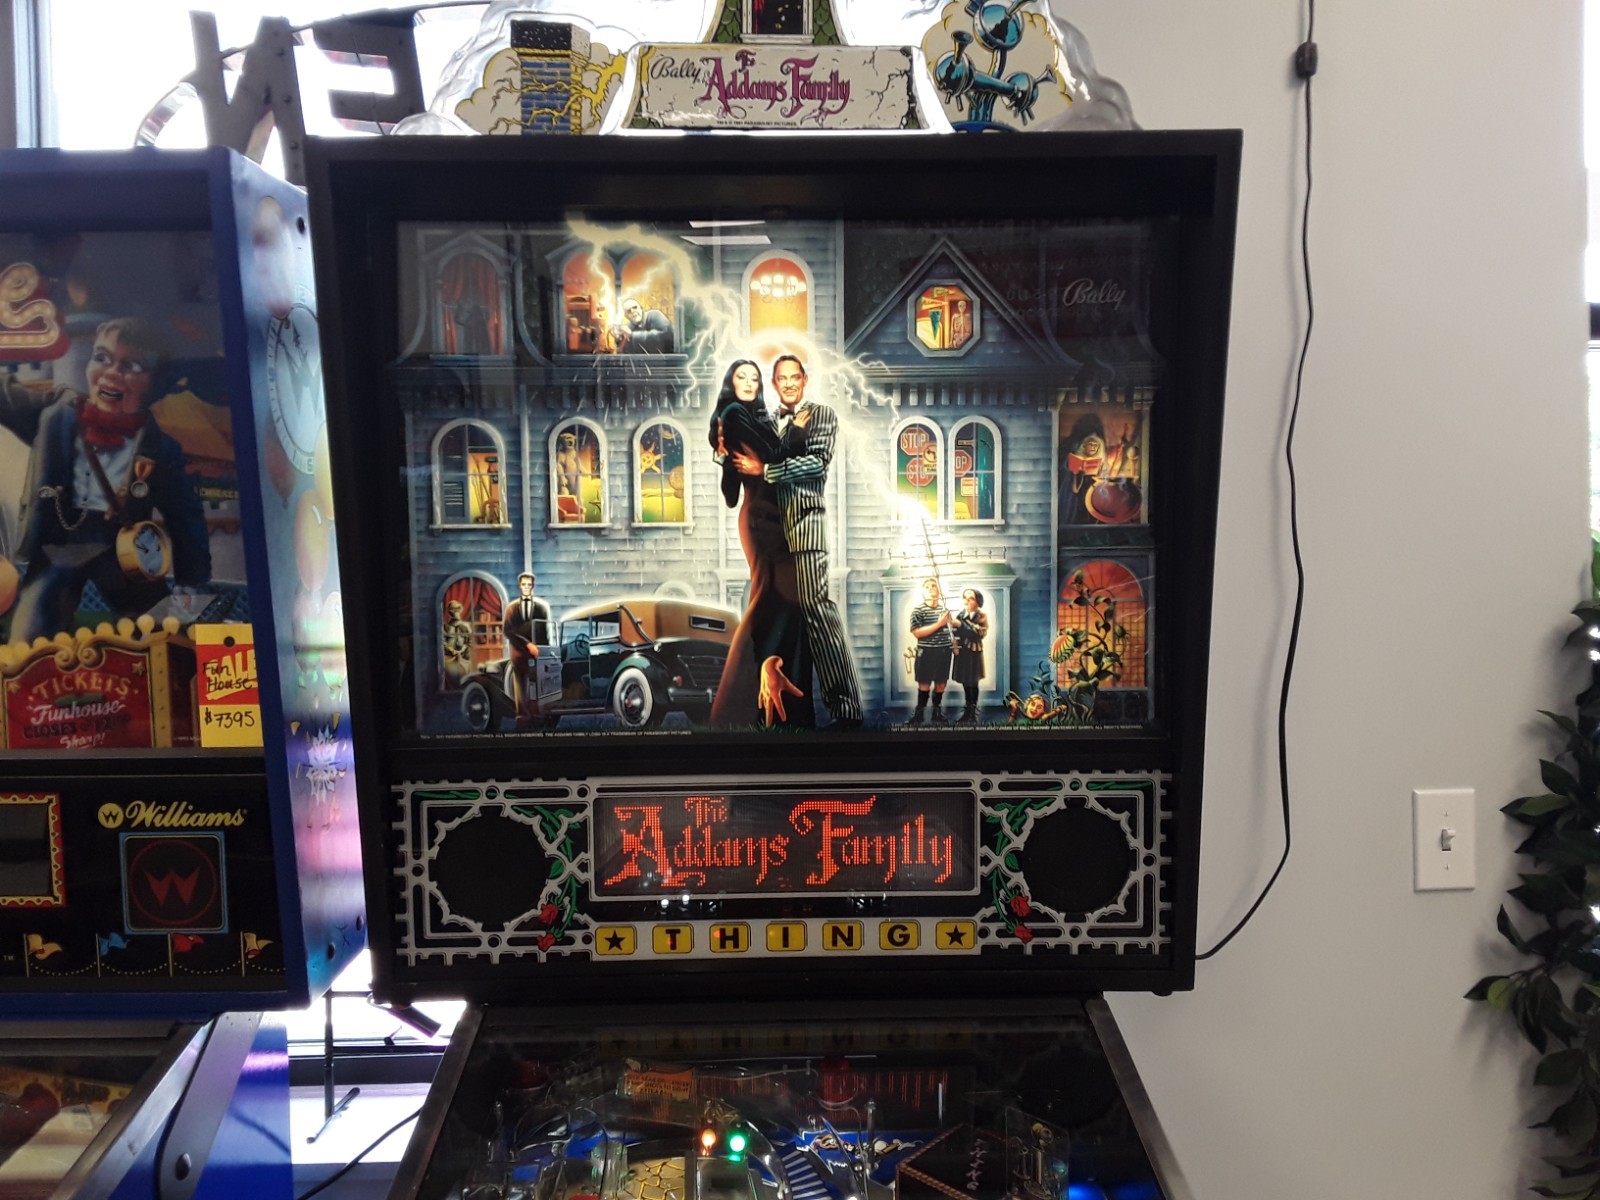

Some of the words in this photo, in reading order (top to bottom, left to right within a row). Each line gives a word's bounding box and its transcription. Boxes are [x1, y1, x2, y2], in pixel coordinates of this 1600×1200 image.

[650, 55, 700, 83] Bally
[694, 57, 788, 118] Addams
[780, 52, 850, 118] Family
[1062, 277, 1127, 311] Bally
[902, 432, 926, 450] STOP
[202, 660, 231, 677] Fun
[32, 671, 131, 699] TICKETS
[207, 674, 253, 693] House
[23, 722, 77, 739] CLOSES
[204, 706, 255, 729] $7395
[125, 800, 245, 828] Williams
[685, 797, 728, 827] The
[604, 806, 790, 887] Addams
[789, 795, 954, 886] Family
